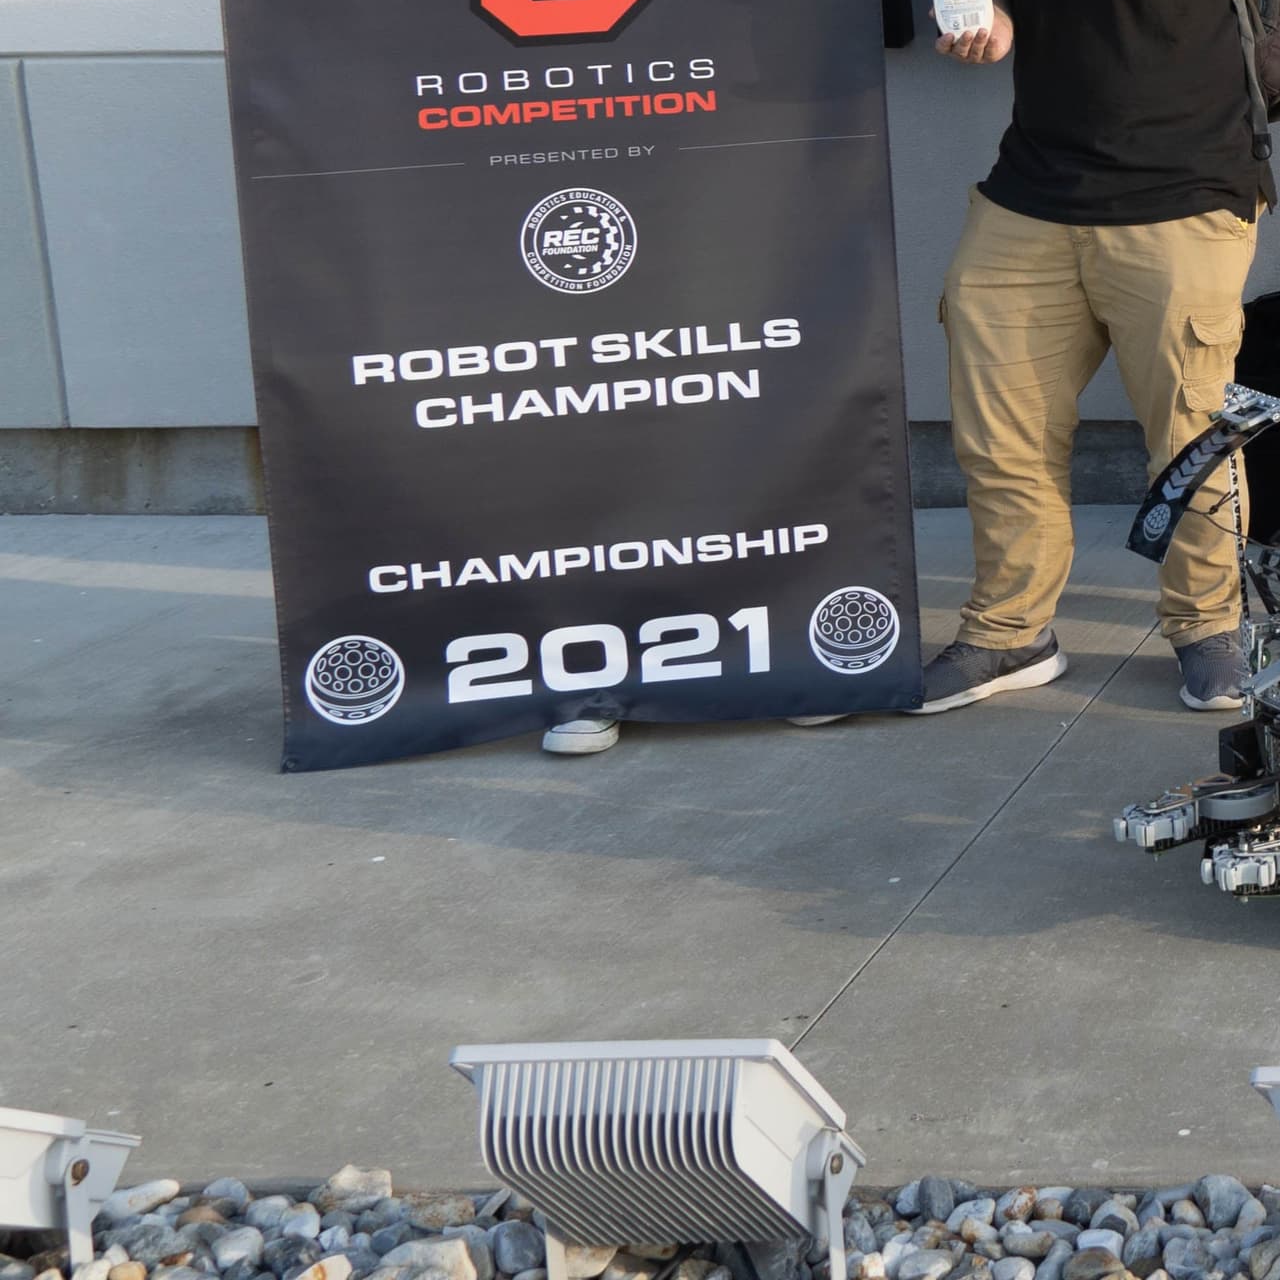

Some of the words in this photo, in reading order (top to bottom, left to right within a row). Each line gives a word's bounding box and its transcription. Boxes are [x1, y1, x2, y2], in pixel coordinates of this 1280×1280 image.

[416, 58, 715, 96] ROBOTICS
[418, 89, 717, 130] COMPETITION
[490, 147, 619, 166] PRESENTED
[628, 145, 655, 158] BY
[528, 194, 567, 229] ROBOTICS
[569, 192, 621, 215] EDUCATION
[542, 244, 598, 256] FOUNDATION
[543, 228, 600, 247] REC
[527, 251, 583, 289] COMPETITION
[586, 244, 632, 288] FOUNDATION
[352, 337, 577, 385] ROBOT
[591, 318, 801, 364] SKILLS
[415, 369, 761, 429] CHAMPION
[368, 523, 829, 593] CHAMPIONSHIP
[446, 606, 770, 704] 2021
